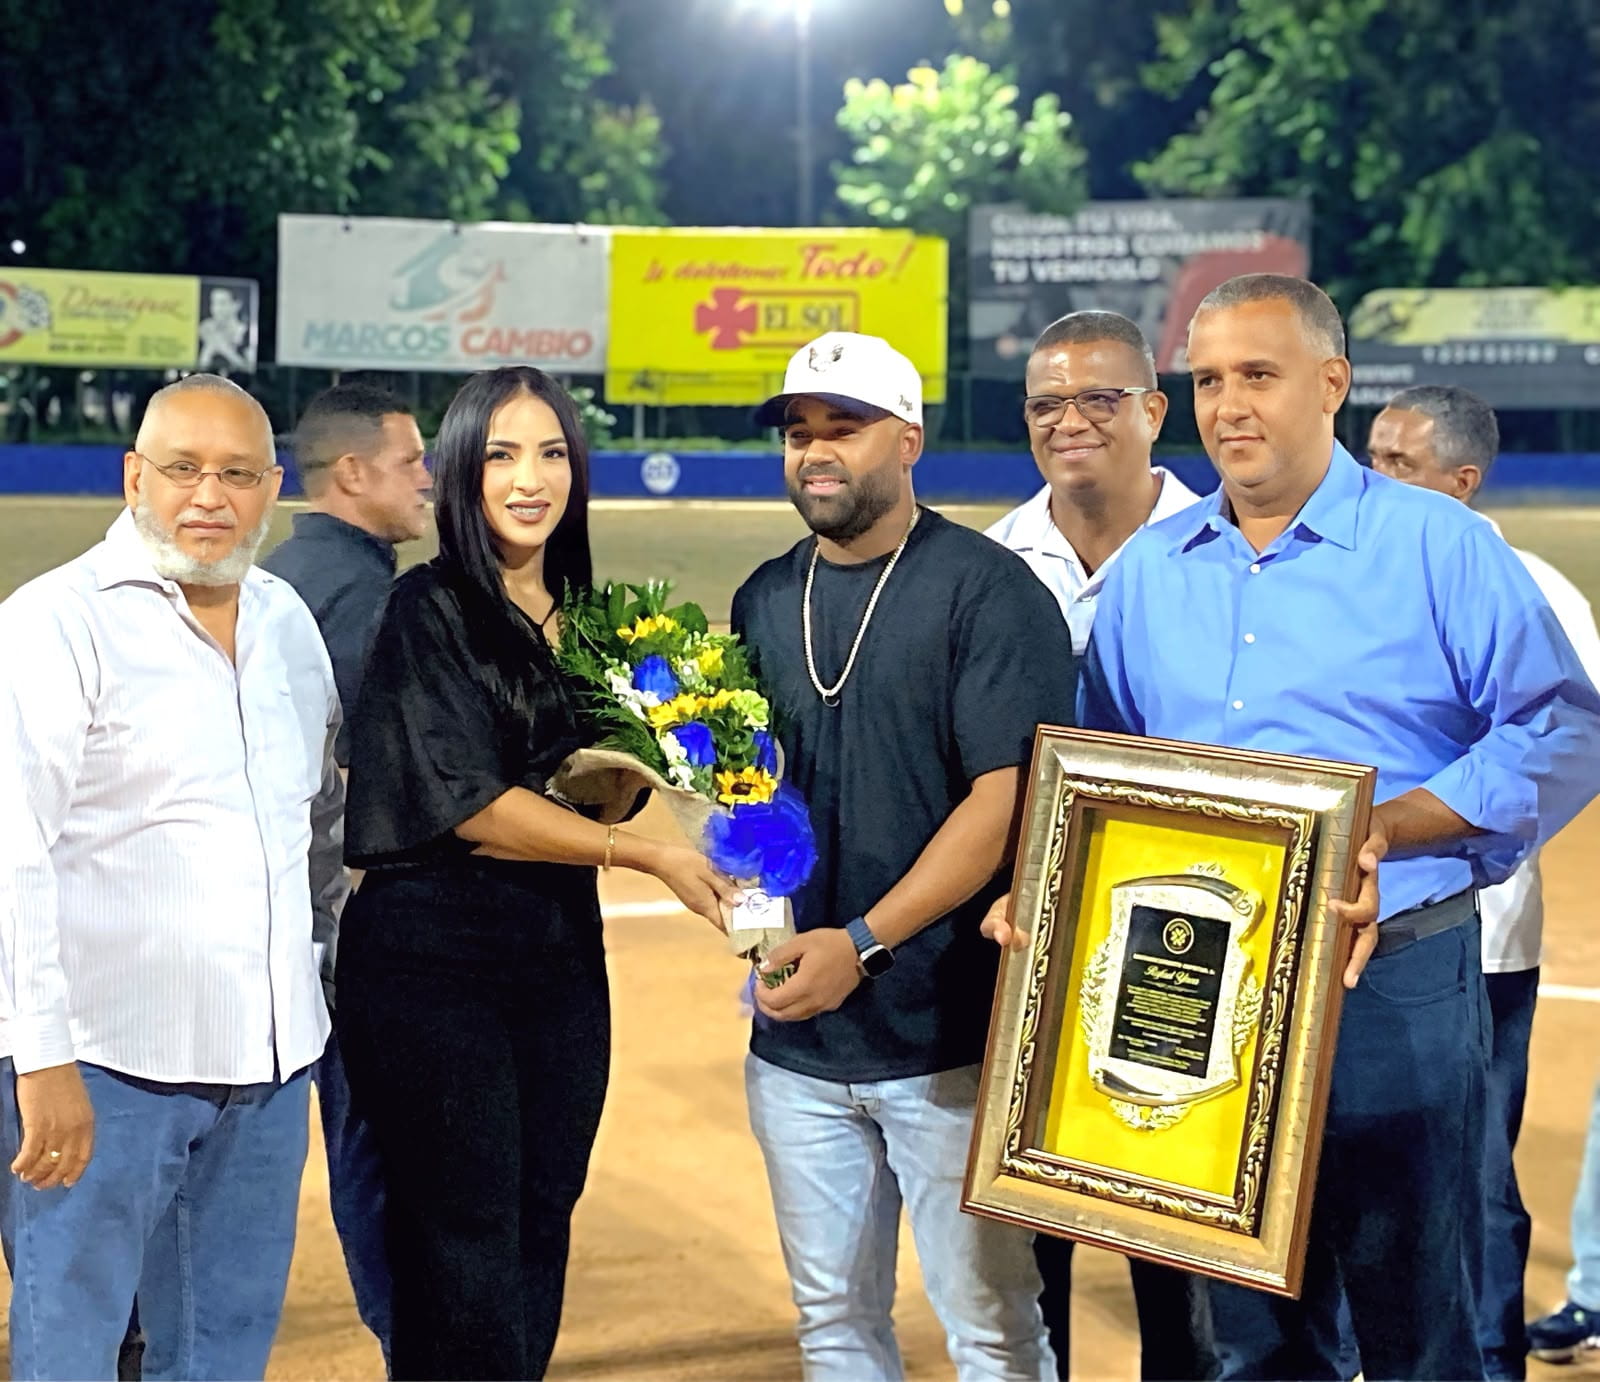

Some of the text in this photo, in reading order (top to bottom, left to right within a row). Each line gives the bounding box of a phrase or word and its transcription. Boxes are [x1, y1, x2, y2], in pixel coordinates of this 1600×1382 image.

[991, 236, 1128, 259] NOSOTROS
[990, 260, 1029, 284] TU
[765, 305, 849, 331] EL SOL
[304, 322, 593, 357] MARCOS CAMBIO
